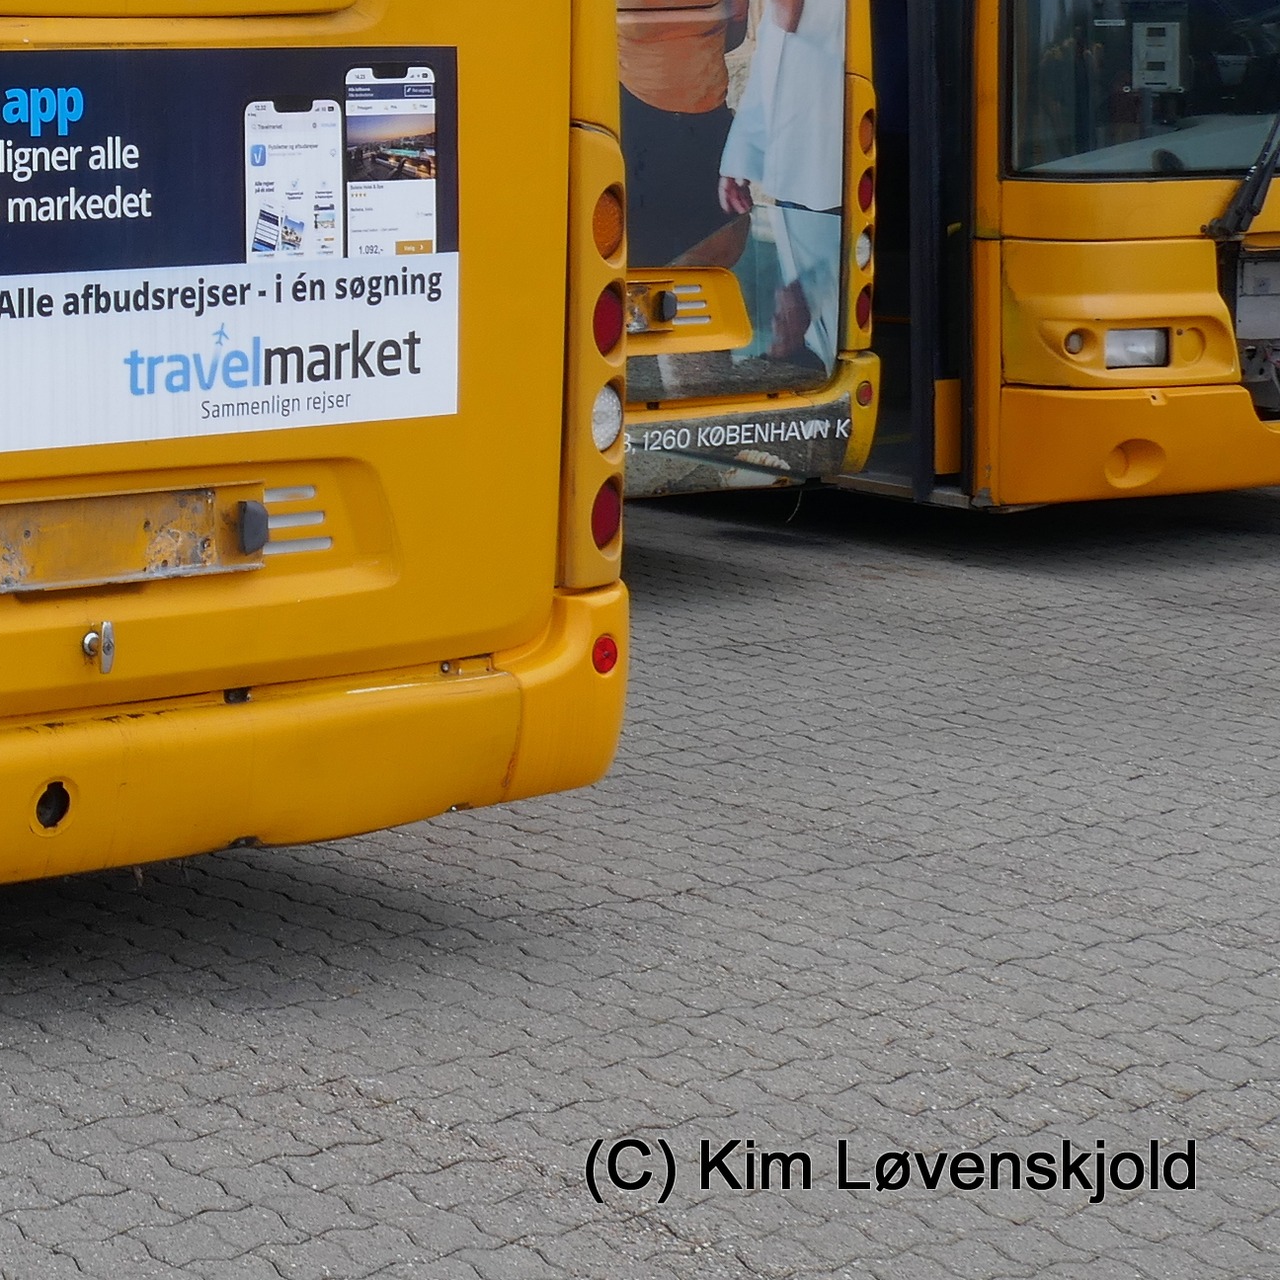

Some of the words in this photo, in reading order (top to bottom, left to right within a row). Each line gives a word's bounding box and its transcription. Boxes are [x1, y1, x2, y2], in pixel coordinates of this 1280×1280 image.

[2, 85, 84, 137] app
[88, 136, 140, 170] alle
[7, 185, 153, 223] markedet
[62, 278, 252, 316] afbudsrejser
[274, 274, 282, 303] i
[291, 271, 326, 302] én
[334, 267, 442, 306] søgning
[124, 329, 421, 396] travelmarket
[200, 394, 301, 420] Sammenlign
[306, 391, 351, 414] rejser
[642, 427, 691, 452] 1260
[697, 419, 829, 448] KØBENHAVN
[835, 418, 851, 439] K
